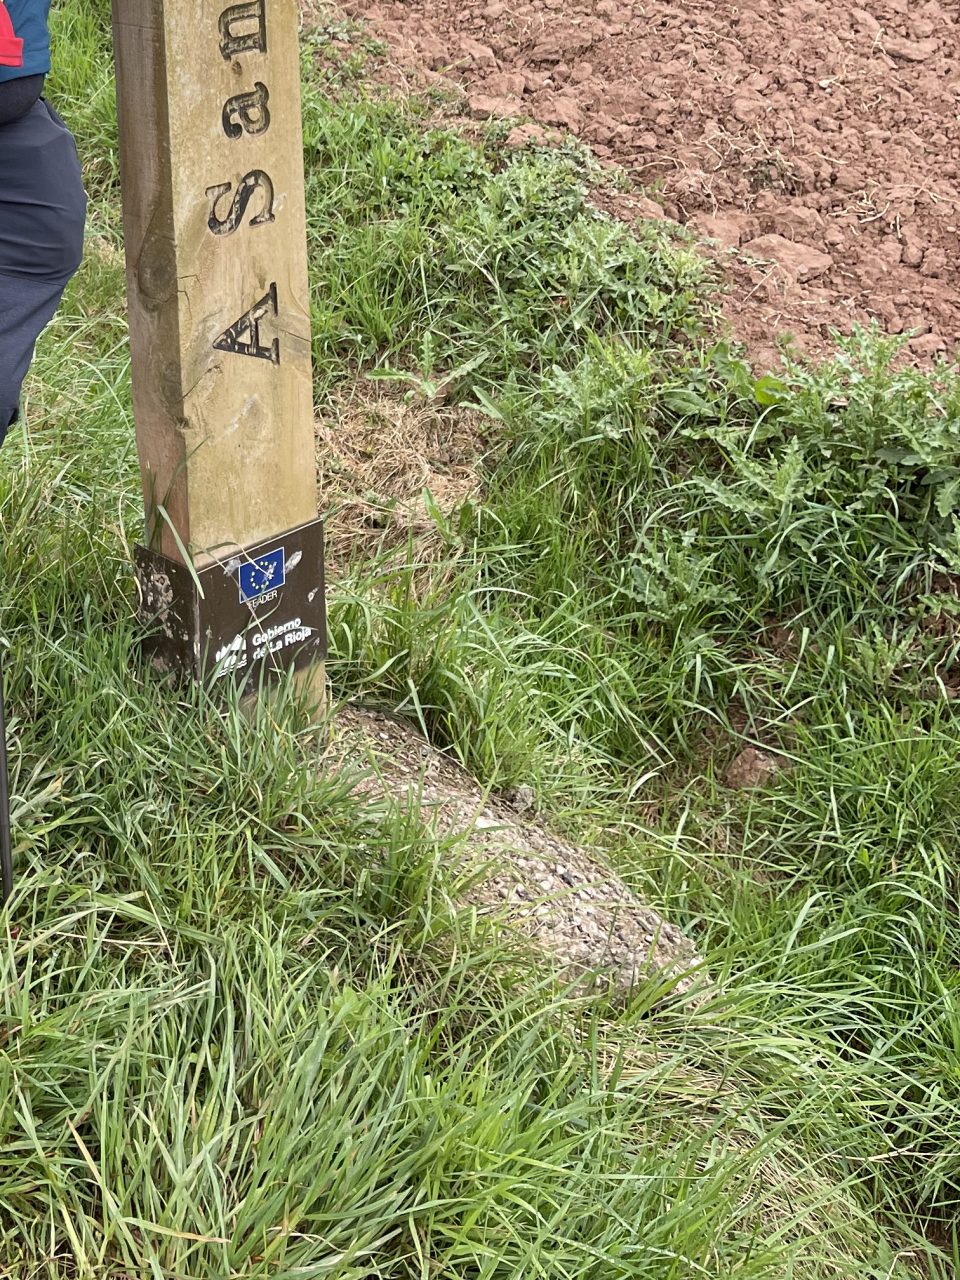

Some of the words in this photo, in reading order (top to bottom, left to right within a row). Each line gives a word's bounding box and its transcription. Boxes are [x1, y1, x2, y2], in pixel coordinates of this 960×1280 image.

[213, 281, 281, 365] A
[252, 618, 302, 646] Gobierno
[269, 640, 283, 653] La
[284, 628, 312, 646] Rioja
